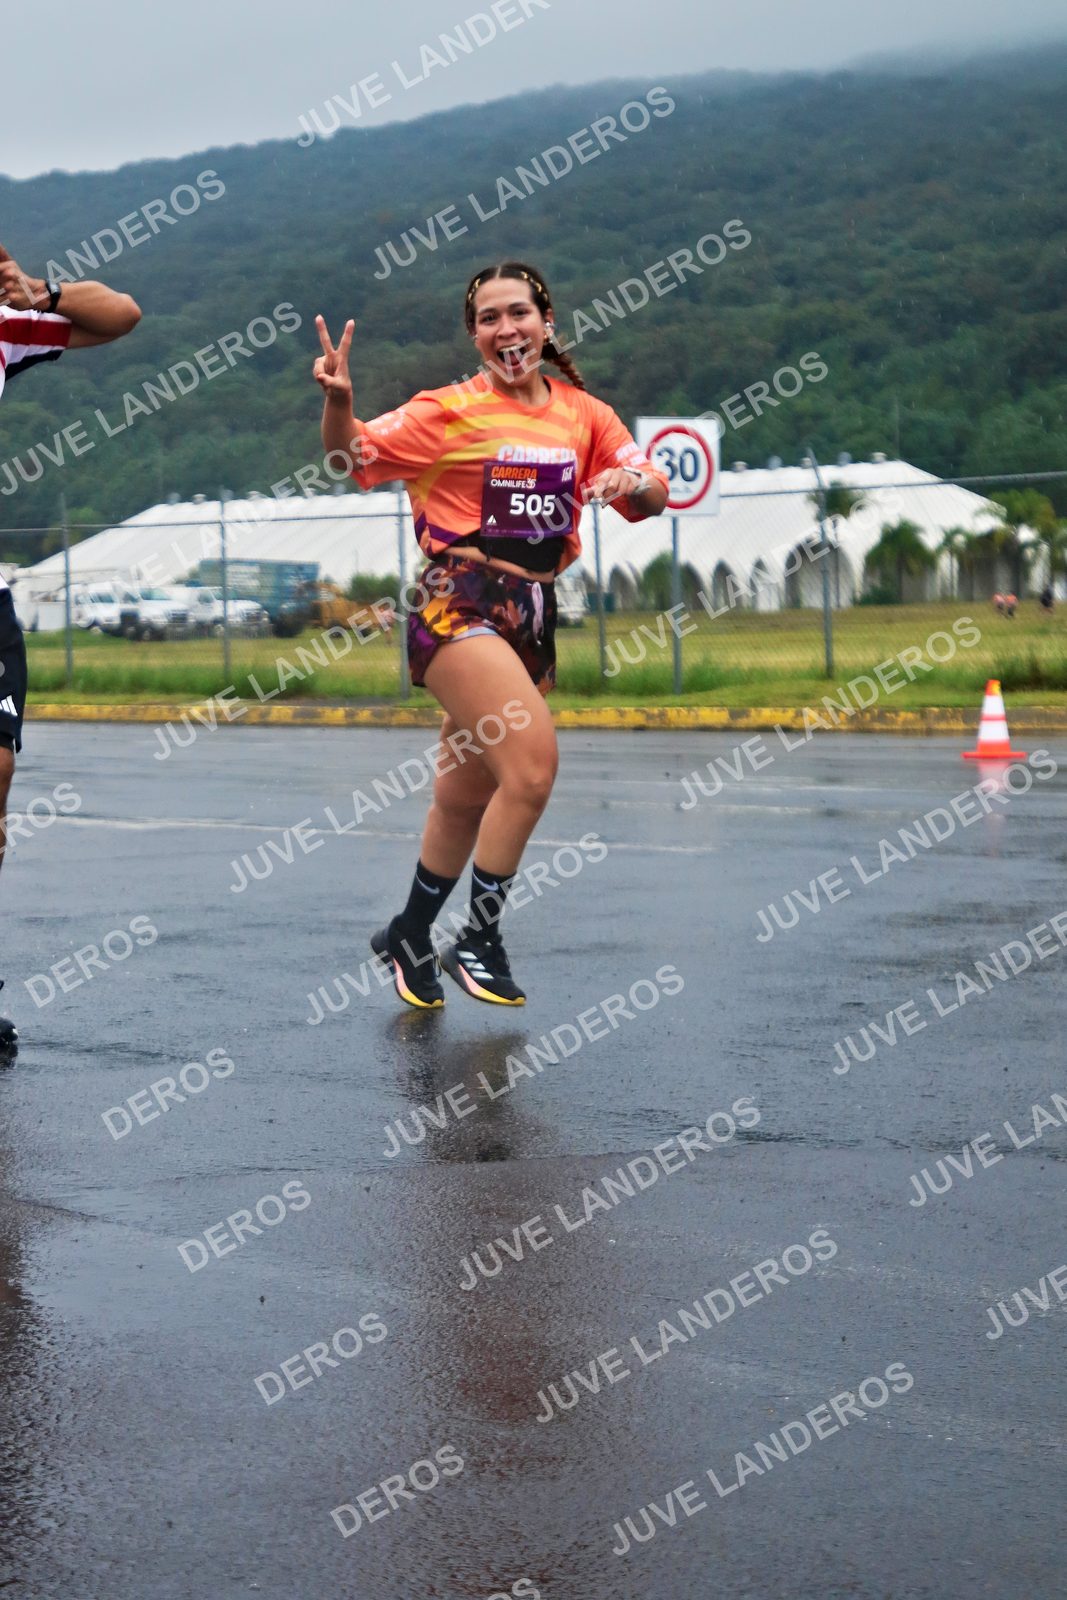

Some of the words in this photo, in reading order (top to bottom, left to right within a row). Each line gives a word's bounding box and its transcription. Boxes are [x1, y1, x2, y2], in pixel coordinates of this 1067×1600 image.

[491, 466, 537, 479] CARRERA
[656, 447, 700, 482] 30
[509, 493, 556, 516] 505
